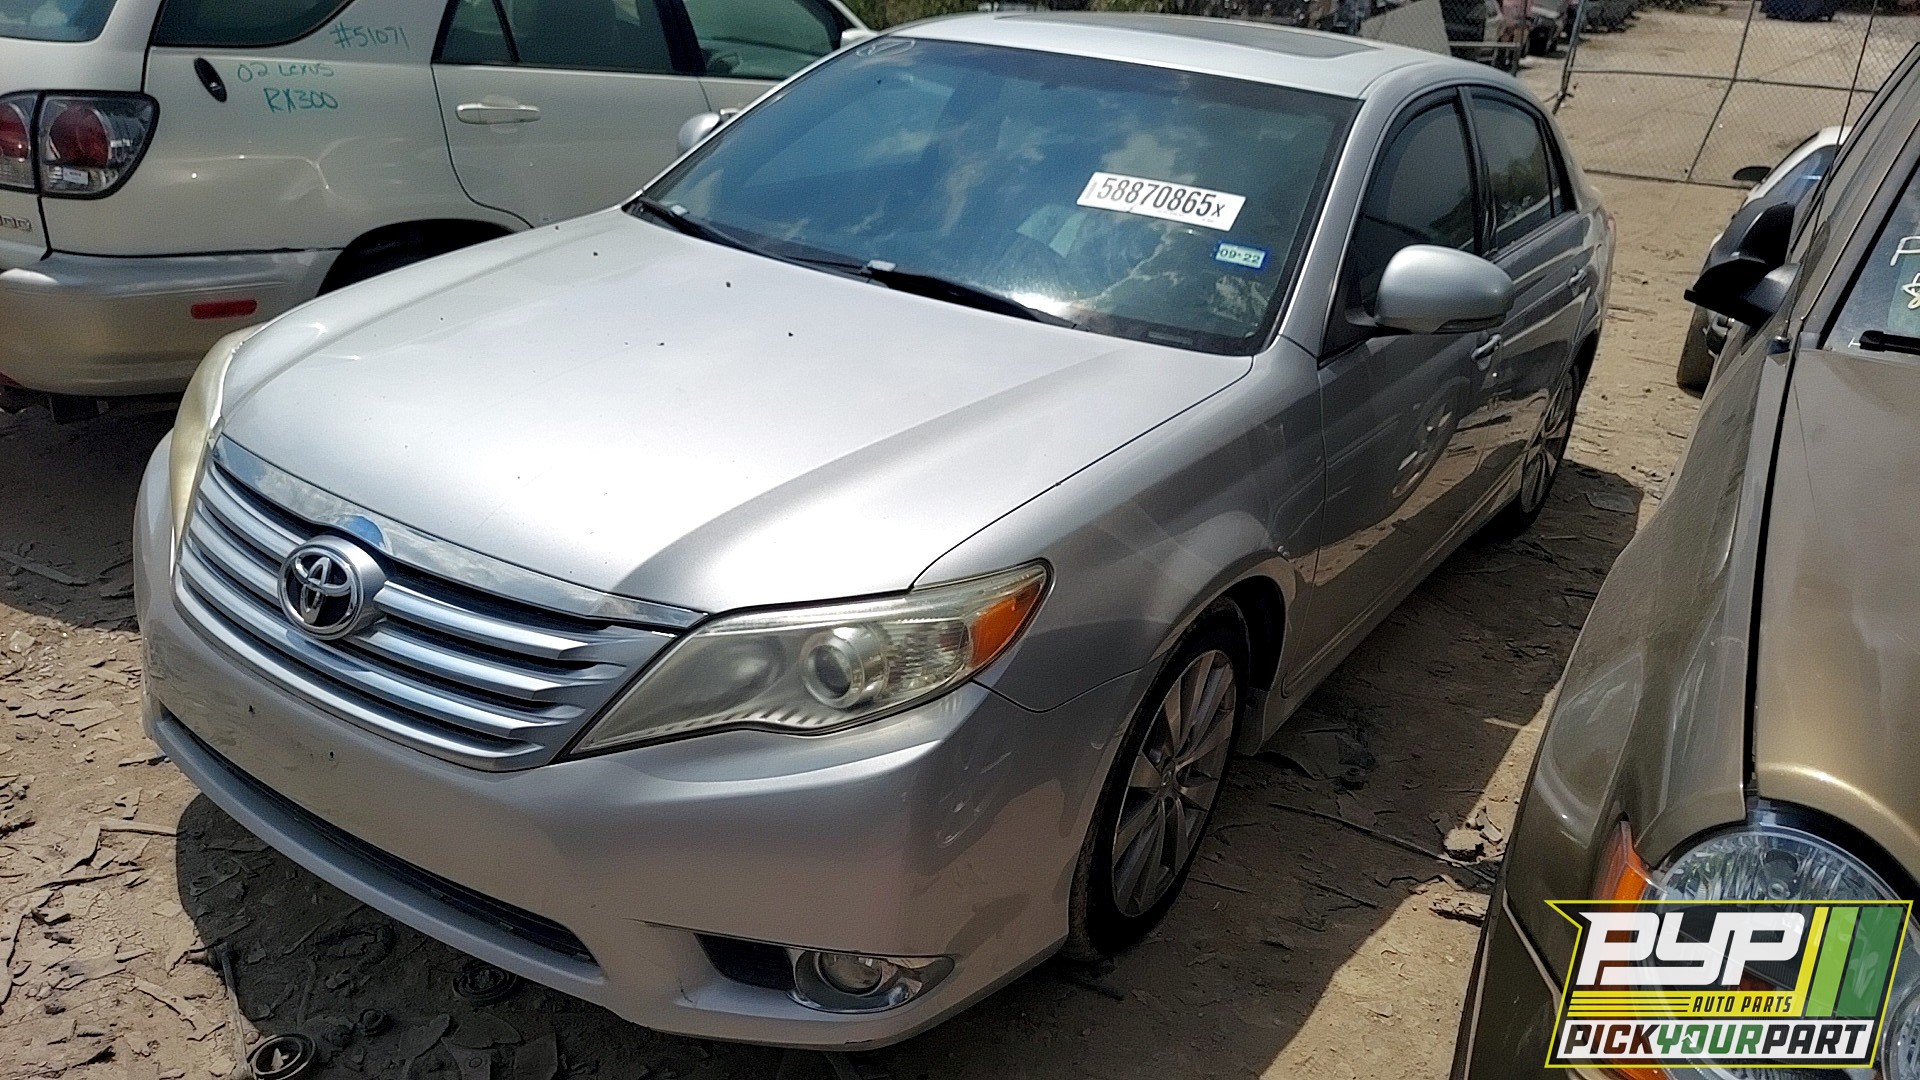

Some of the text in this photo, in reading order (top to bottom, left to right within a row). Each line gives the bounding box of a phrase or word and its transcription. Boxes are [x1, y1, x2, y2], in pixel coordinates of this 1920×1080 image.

[330, 22, 410, 50] #51071
[237, 62, 268, 82] 02
[263, 88, 338, 113] RX300
